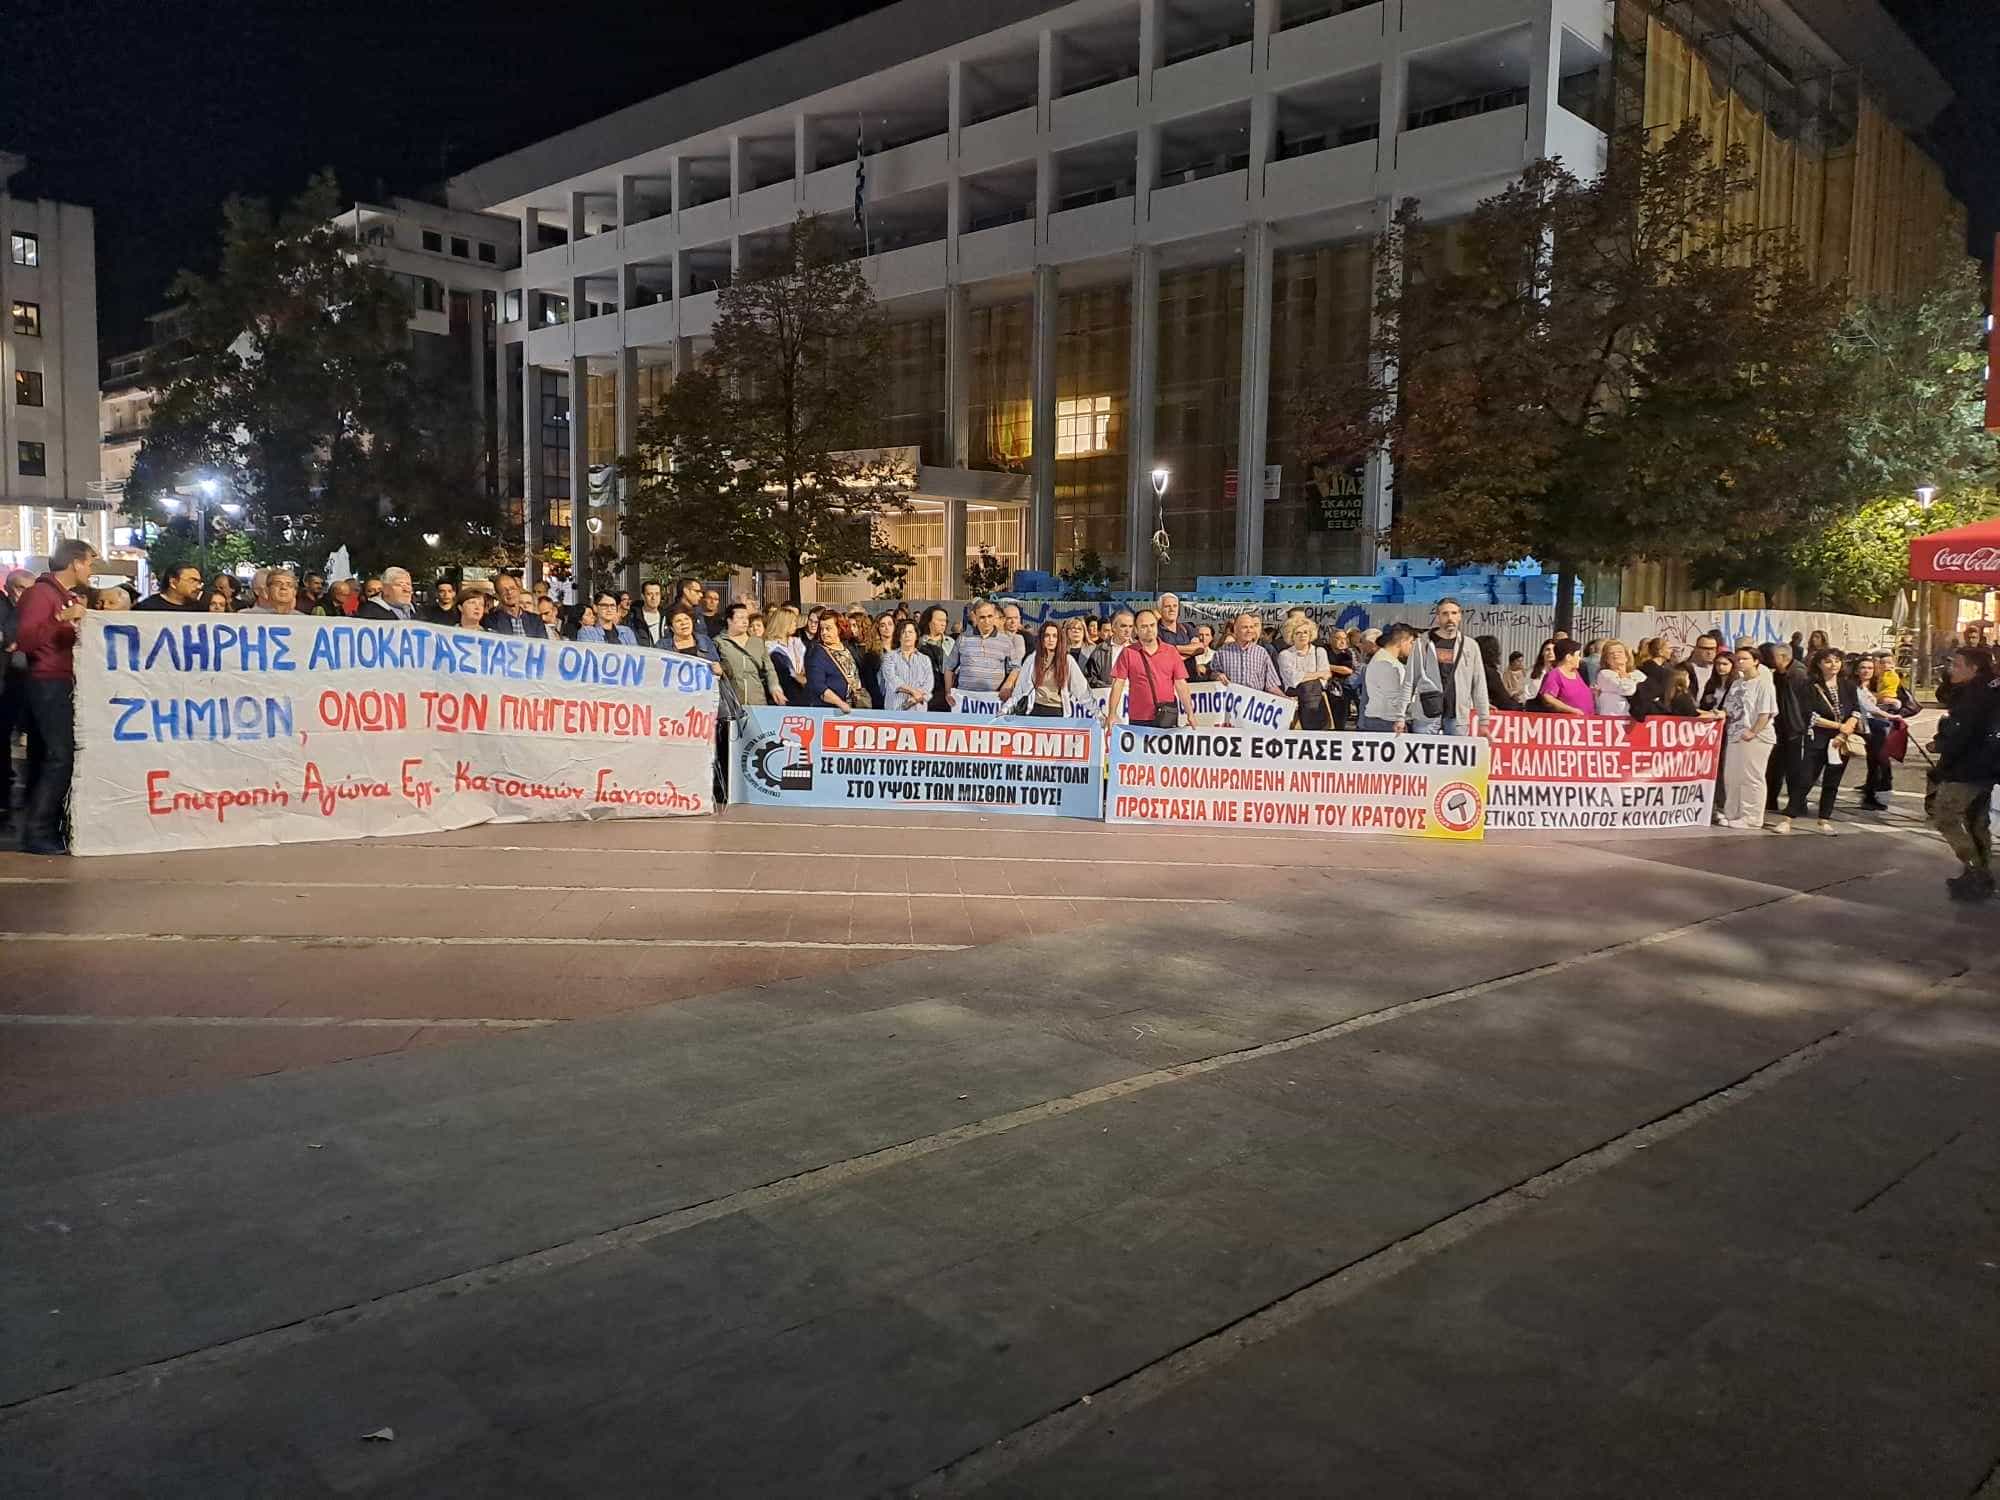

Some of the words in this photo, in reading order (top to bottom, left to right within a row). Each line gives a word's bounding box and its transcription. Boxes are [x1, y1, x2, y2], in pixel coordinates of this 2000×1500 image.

[103, 624, 297, 673] ΠΛΗΡΗΣ
[309, 626, 545, 679] ΑΠΟΚΑΤΑΣΤΑΣΗ
[558, 645, 646, 687] ΟΛΩΝ
[319, 690, 407, 732] ΟΛΩΝ
[420, 692, 488, 733] ΤΩΝ
[500, 695, 651, 737] ΠΛΗΓΕΝΤΩΝ
[834, 725, 918, 752] ΤΩΡΑ
[925, 728, 1084, 758] ΠΛΗΡΩΜΗ
[1120, 731, 1135, 753] Ο
[1143, 734, 1242, 758] ΚΟΜΠΟΣ
[1251, 737, 1342, 761] ΕΦΤΑΣΕ
[1351, 740, 1396, 762] ΣΤΟ
[1403, 742, 1477, 767] ΧΤΕΝΙ
[1645, 720, 1718, 748] 100%
[820, 757, 834, 774] ΣΕ
[836, 757, 876, 776] ΟΛΟΥΣ
[879, 759, 908, 776] ΤΟΥΣ
[911, 760, 1003, 780] ΕΡΓΑΖΟΜΕΝΟΥΣ
[1005, 764, 1024, 781] ΜΕ
[1025, 765, 1090, 785] ΑΝΑΣΤΟΛΗ
[1118, 764, 1156, 787] ΤΩΡΑ
[1160, 766, 1285, 792] ΟΛΟΚΛΗΡΩΜΕΝΗ
[1289, 771, 1428, 797] ΑΝΤΙΠΛΗΜΜΥΡΙΚΗ
[302, 761, 392, 816] Αγώνα
[846, 780, 875, 799] ΣΤΟ
[878, 780, 921, 800] ΥΨΟΣ
[924, 782, 954, 801] ΤΩΝ
[957, 783, 1017, 805] ΜΙΣΘΩΝ
[1020, 786, 1063, 806] ΤΟΥΣ!
[1621, 787, 1664, 807] ΕΡΓΑ
[1672, 784, 1704, 806] ΤΩΡΑ
[1115, 796, 1208, 821] ΠΡΟΣΤΑΣΙΑ
[1212, 800, 1238, 822] ΜΕ
[1243, 802, 1309, 826] ΕΥΘΥΝΗ
[1315, 804, 1348, 826] ΤΟΥ
[1351, 806, 1427, 830] ΚΡΑΤΟΥΣ
[1541, 811, 1618, 827] ΣΥΛΛΟΓΟΣ
[1622, 808, 1702, 827] ΚΟΥΛΟΥΡΙΟΥ
